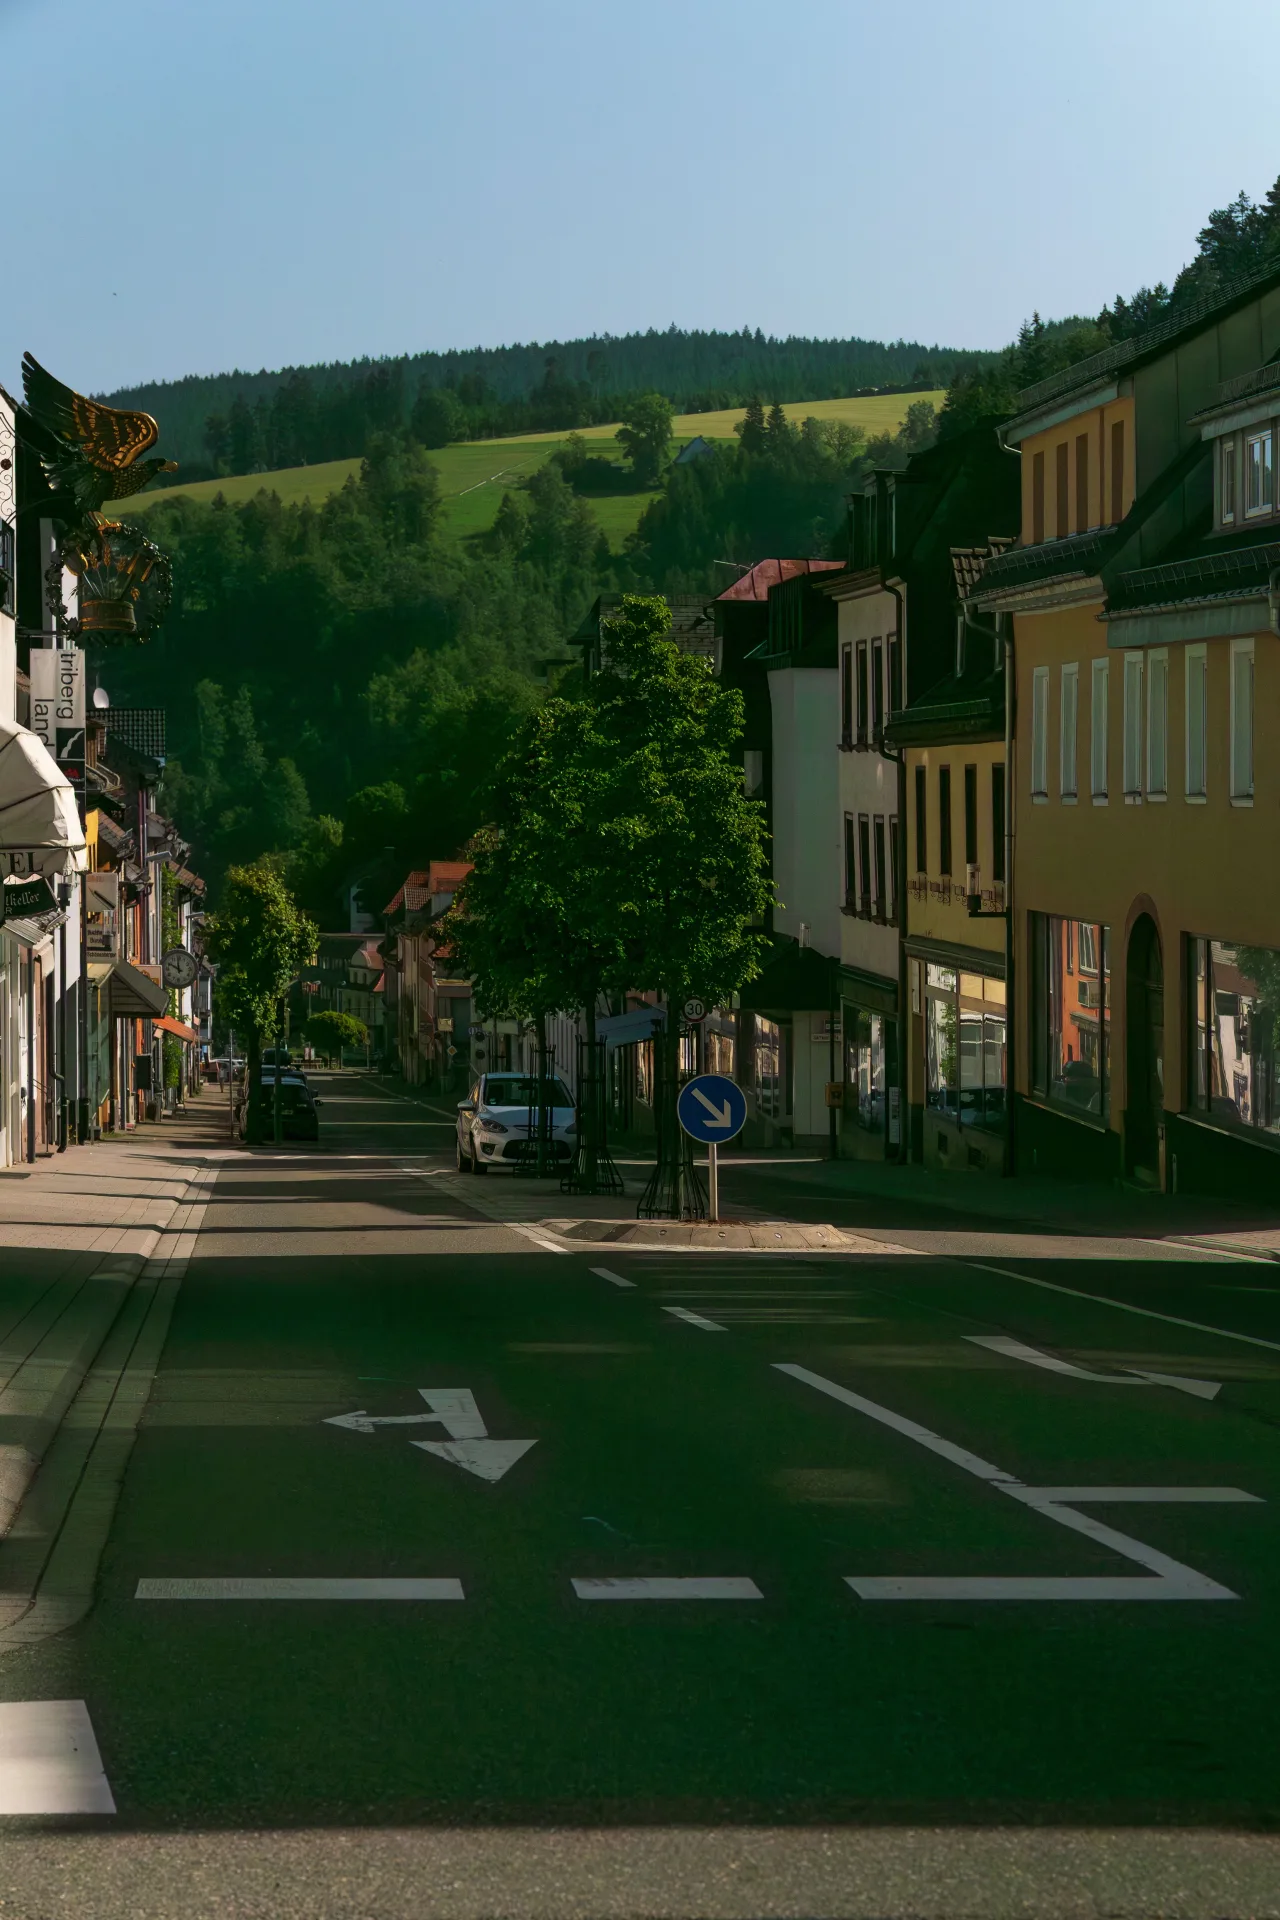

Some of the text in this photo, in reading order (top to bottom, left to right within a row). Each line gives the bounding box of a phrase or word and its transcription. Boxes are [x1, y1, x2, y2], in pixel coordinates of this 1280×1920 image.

[56, 652, 78, 719] triberg
[35, 699, 55, 746] land
[687, 1003, 703, 1016] 30
